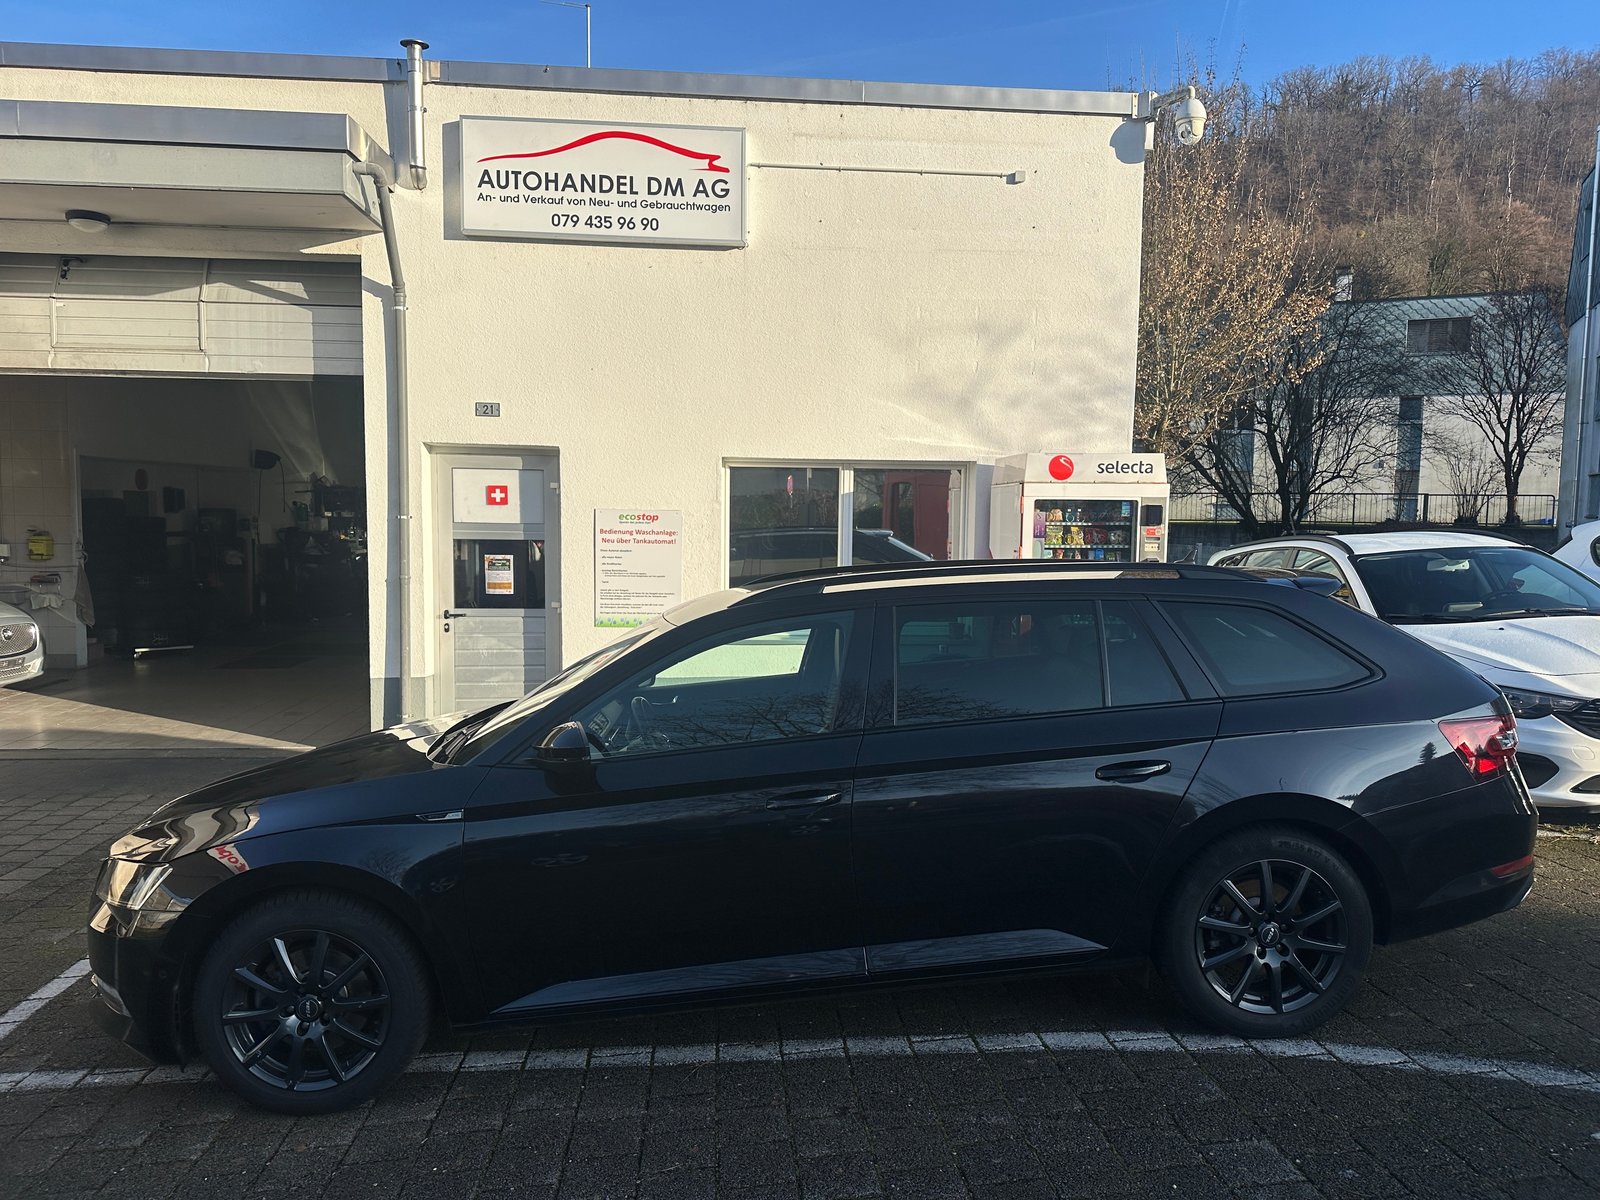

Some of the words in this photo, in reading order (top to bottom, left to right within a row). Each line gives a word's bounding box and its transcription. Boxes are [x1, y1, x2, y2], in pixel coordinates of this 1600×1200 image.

[477, 168, 638, 195] AUTOHANDEL
[647, 176, 685, 197] DM
[692, 178, 730, 199] AG
[477, 192, 496, 202] An-
[499, 194, 520, 203] und
[522, 194, 564, 205] Verkauf
[566, 198, 586, 206] von
[588, 197, 614, 208] Neu-
[617, 199, 637, 208] und
[640, 199, 731, 213] Gebrauchtwagen
[551, 213, 580, 228] 079
[584, 215, 613, 229] 435
[617, 216, 636, 230] 96
[640, 217, 660, 231] 90
[482, 404, 494, 415] 21
[1096, 460, 1154, 474] selecta
[618, 513, 659, 523] ecostop
[599, 528, 634, 536] Bedienung
[634, 529, 679, 537] Waschanlage:
[632, 537, 677, 545] Tankautomat!
